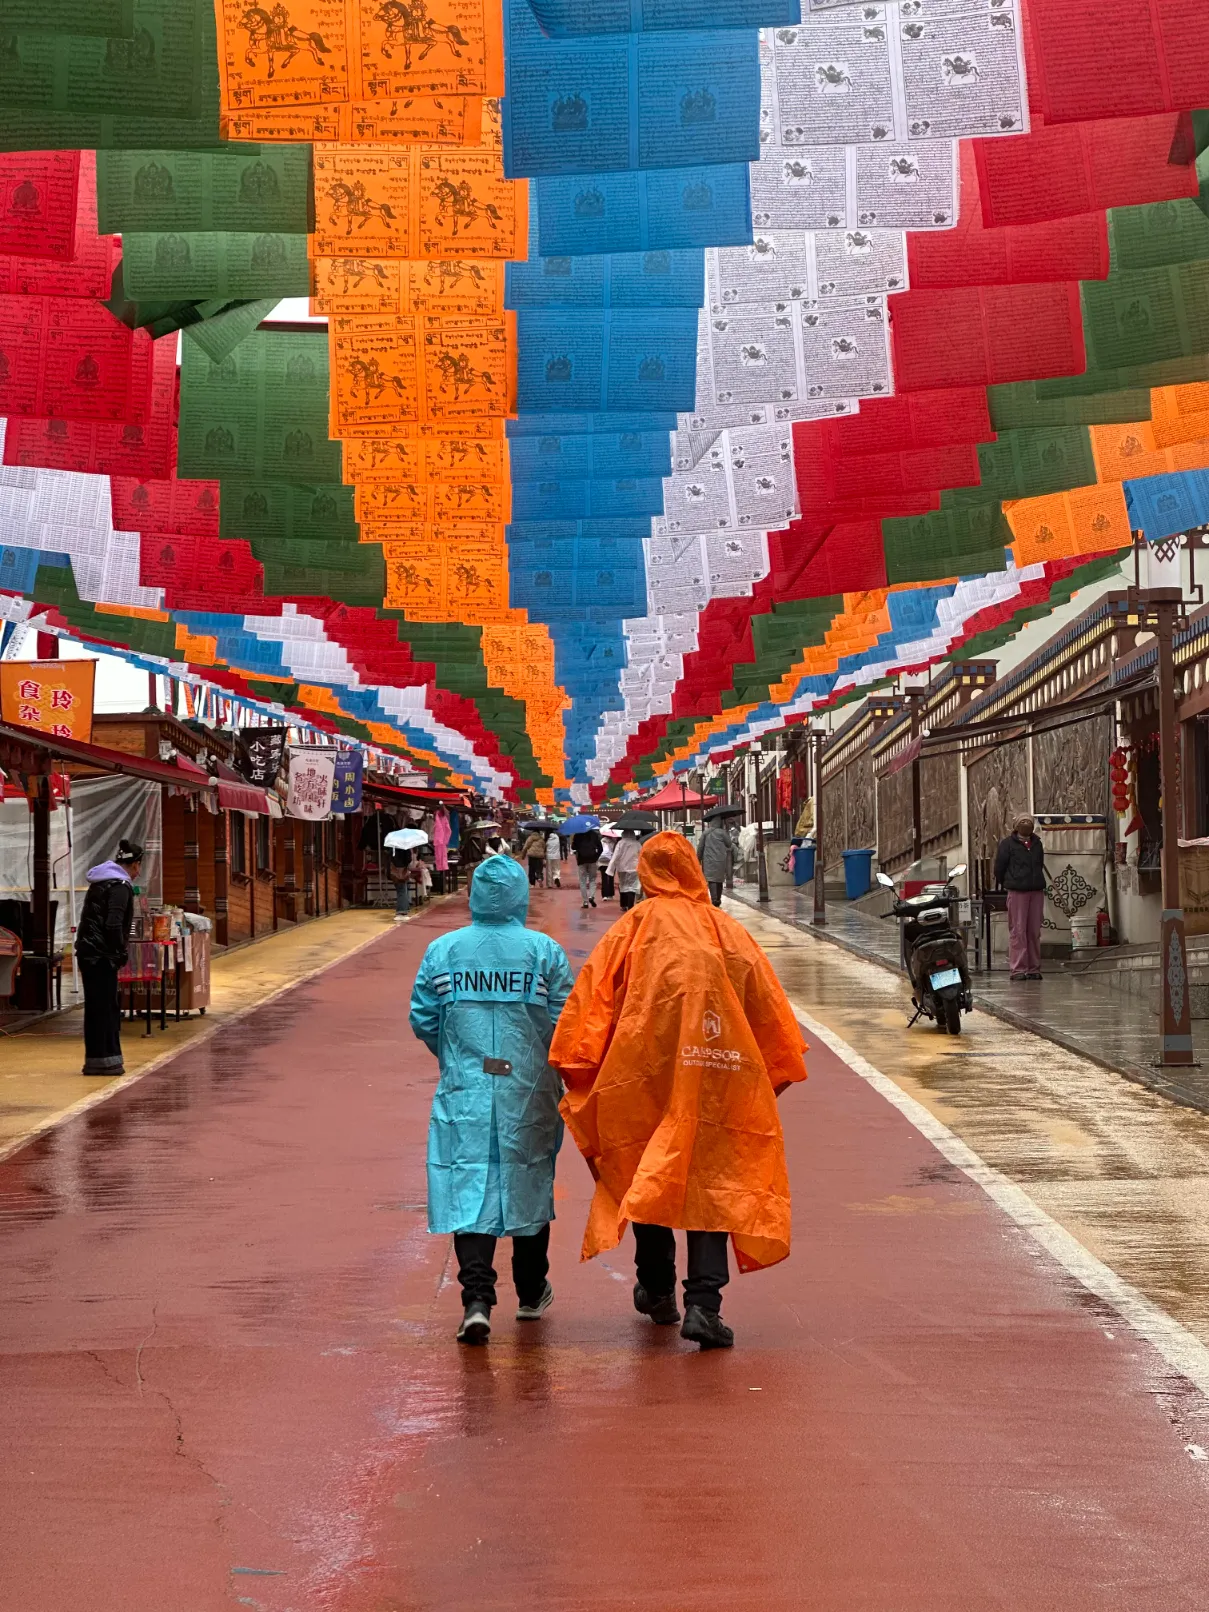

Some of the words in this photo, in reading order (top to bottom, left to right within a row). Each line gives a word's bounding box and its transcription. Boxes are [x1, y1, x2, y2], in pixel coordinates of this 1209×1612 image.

[18, 680, 41, 731] 食杂
[51, 690, 73, 738] 玲玲
[250, 741, 265, 780] 小吃店
[303, 767, 316, 813] 地方风味
[343, 772, 356, 808] 周小卤
[453, 970, 534, 993] RNNNER
